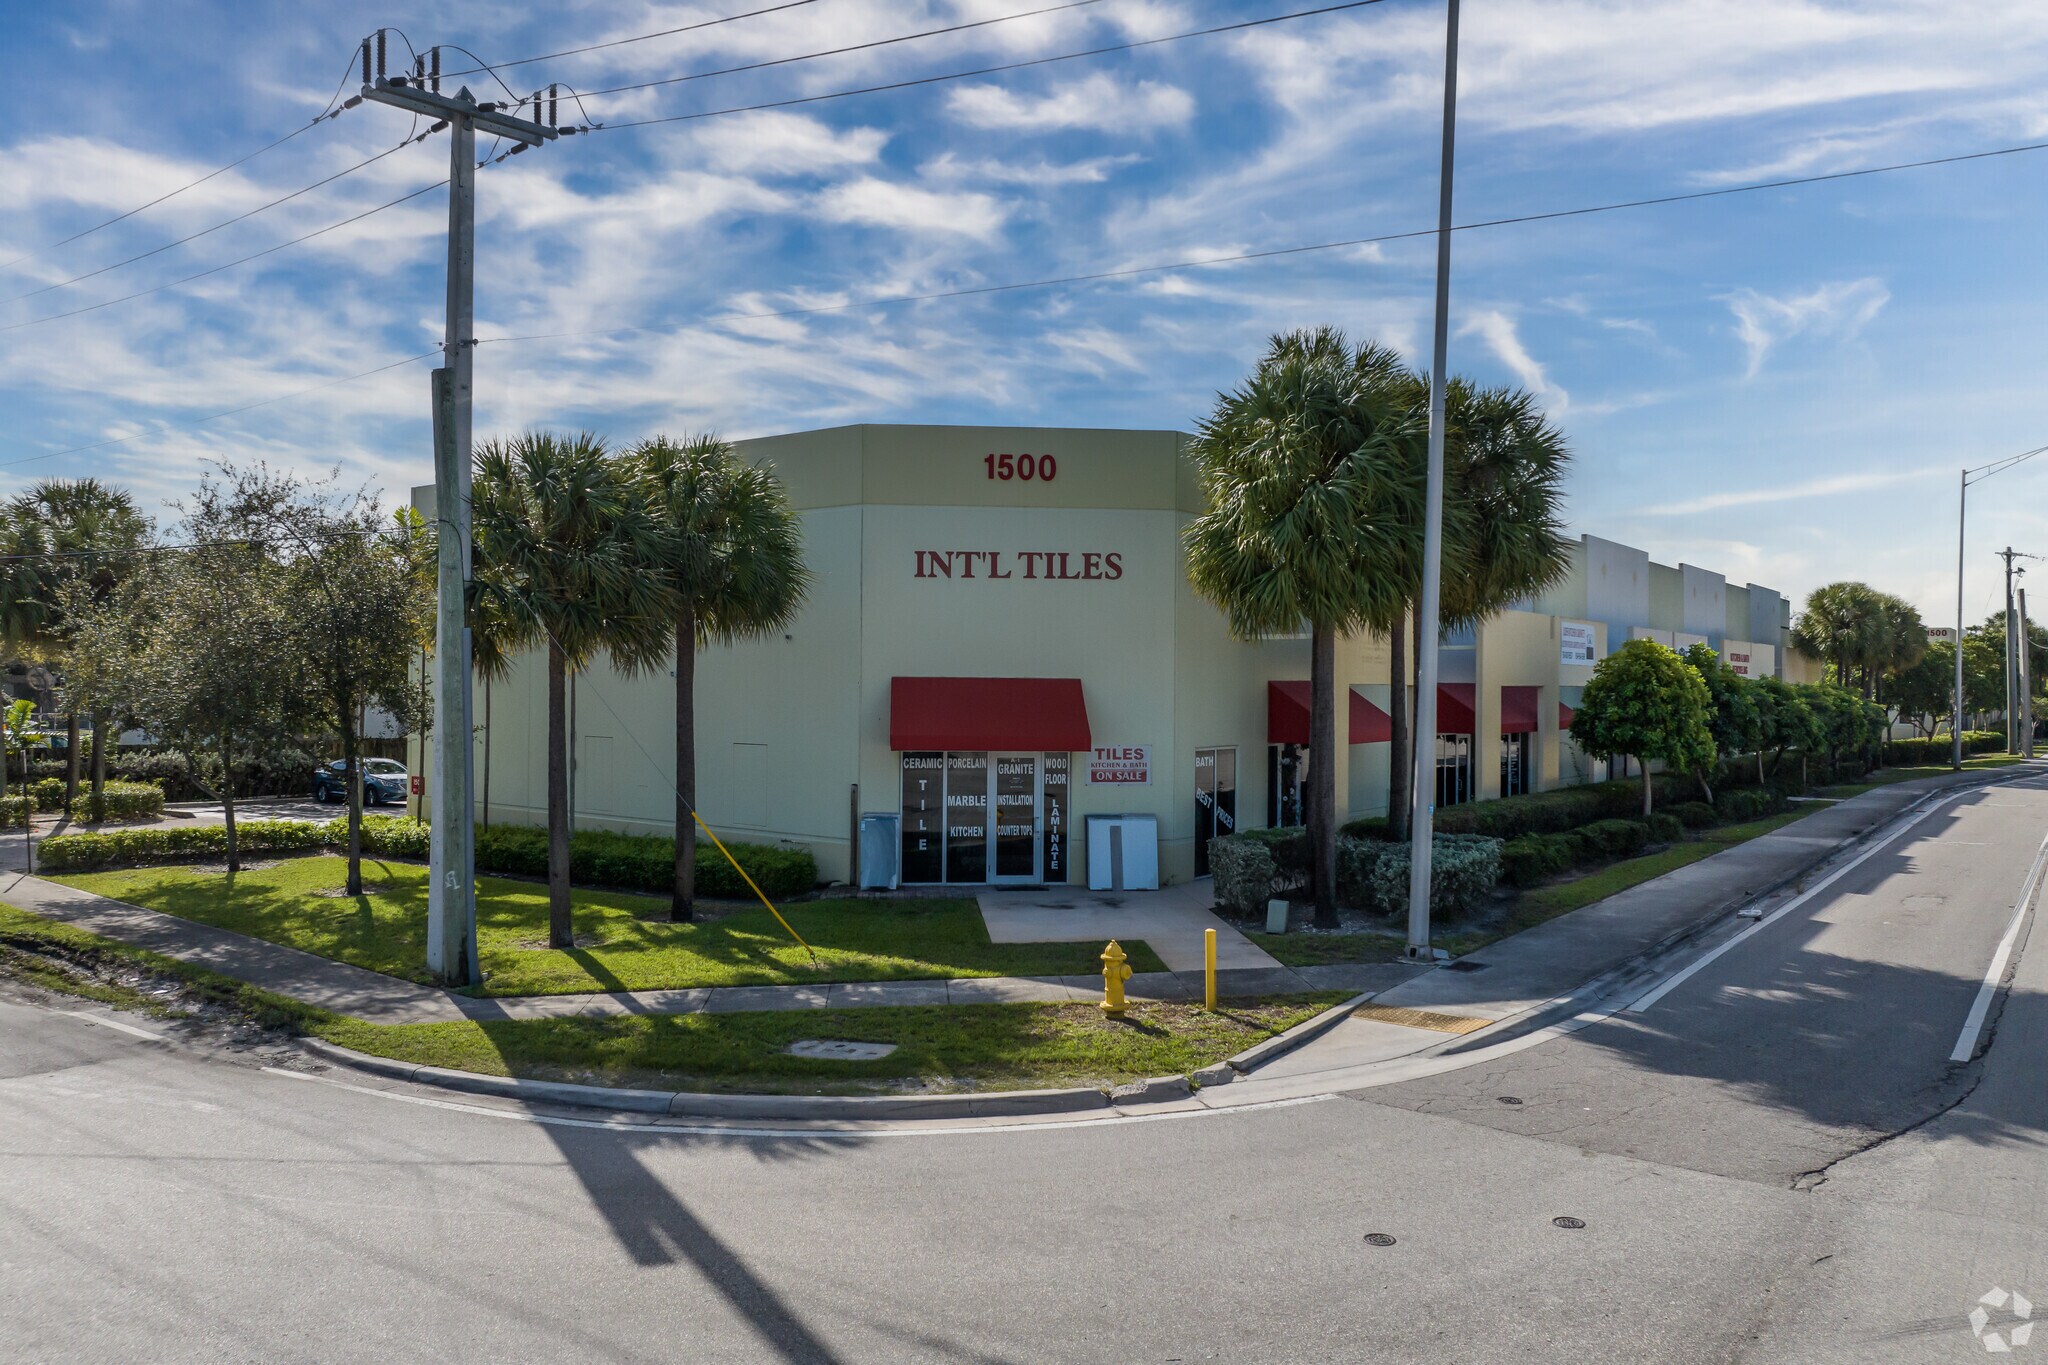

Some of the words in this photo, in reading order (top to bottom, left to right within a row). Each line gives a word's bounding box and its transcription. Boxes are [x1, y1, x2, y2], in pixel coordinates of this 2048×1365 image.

[984, 454, 1056, 481] 1500
[914, 551, 1011, 579] INT'L
[1018, 552, 1123, 580] TILES
[1094, 748, 1144, 760] TILES
[903, 758, 943, 769] CERAMIC
[948, 758, 987, 769] PORCELAIN
[1045, 758, 1067, 769] WOOD
[1196, 756, 1213, 767] BATH
[998, 763, 1034, 775] GRANITE
[1045, 774, 1067, 785] FLOOR
[1096, 771, 1113, 781] ON
[1116, 771, 1142, 781] SALE
[947, 795, 987, 807] MARBLE
[997, 794, 1033, 806] INSTALLATION
[1196, 787, 1212, 808] BEST
[919, 780, 927, 850] TILE
[1216, 806, 1233, 829] PRICES
[950, 826, 983, 837] KITCHEN
[997, 825, 1020, 836] COUNTER
[1020, 825, 1033, 836] TOPS
[1051, 799, 1059, 869] LAMINATE
